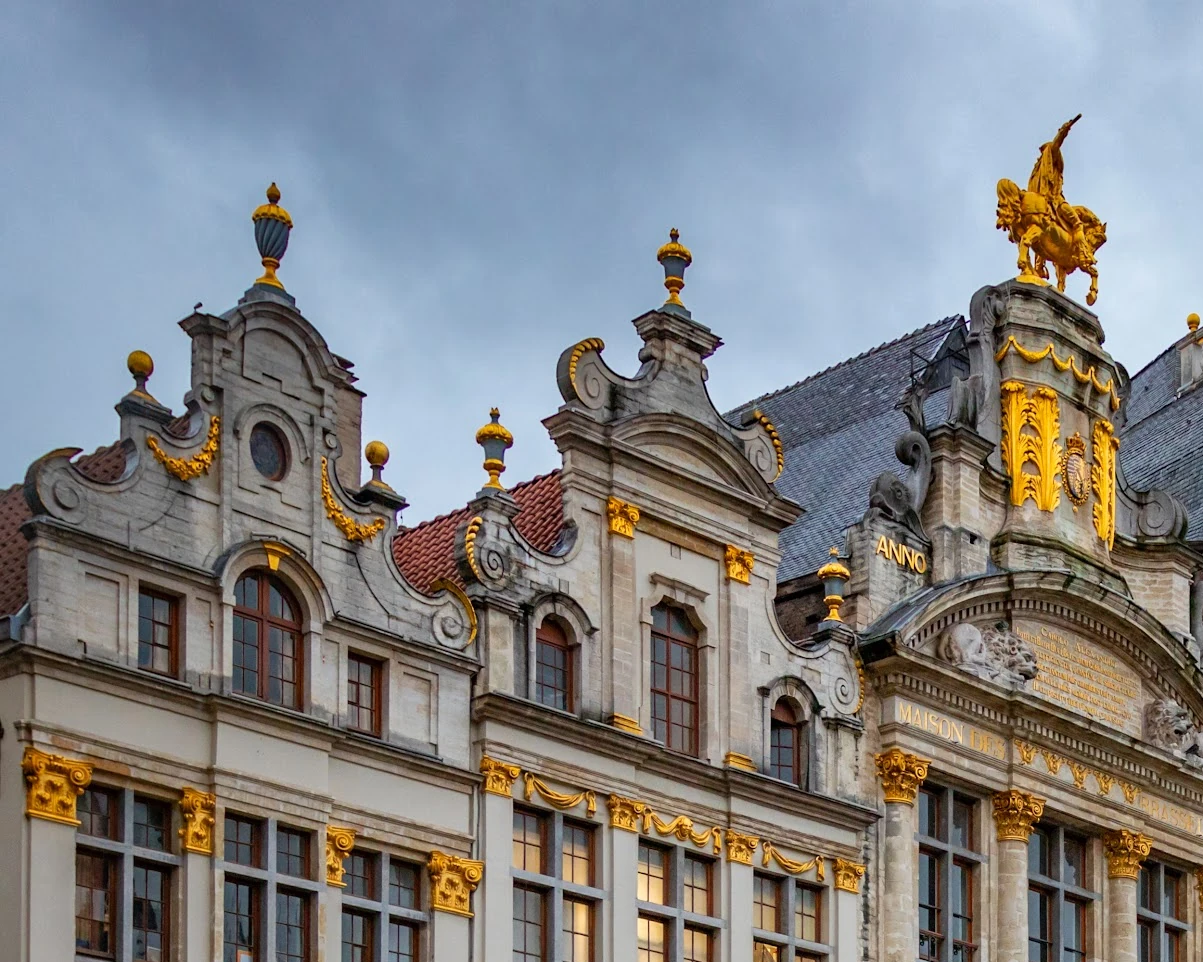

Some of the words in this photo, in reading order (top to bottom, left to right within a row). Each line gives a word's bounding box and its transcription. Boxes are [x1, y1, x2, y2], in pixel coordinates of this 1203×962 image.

[876, 535, 928, 574] ANNO
[899, 702, 964, 745] MAISON
[969, 727, 1006, 760] DES
